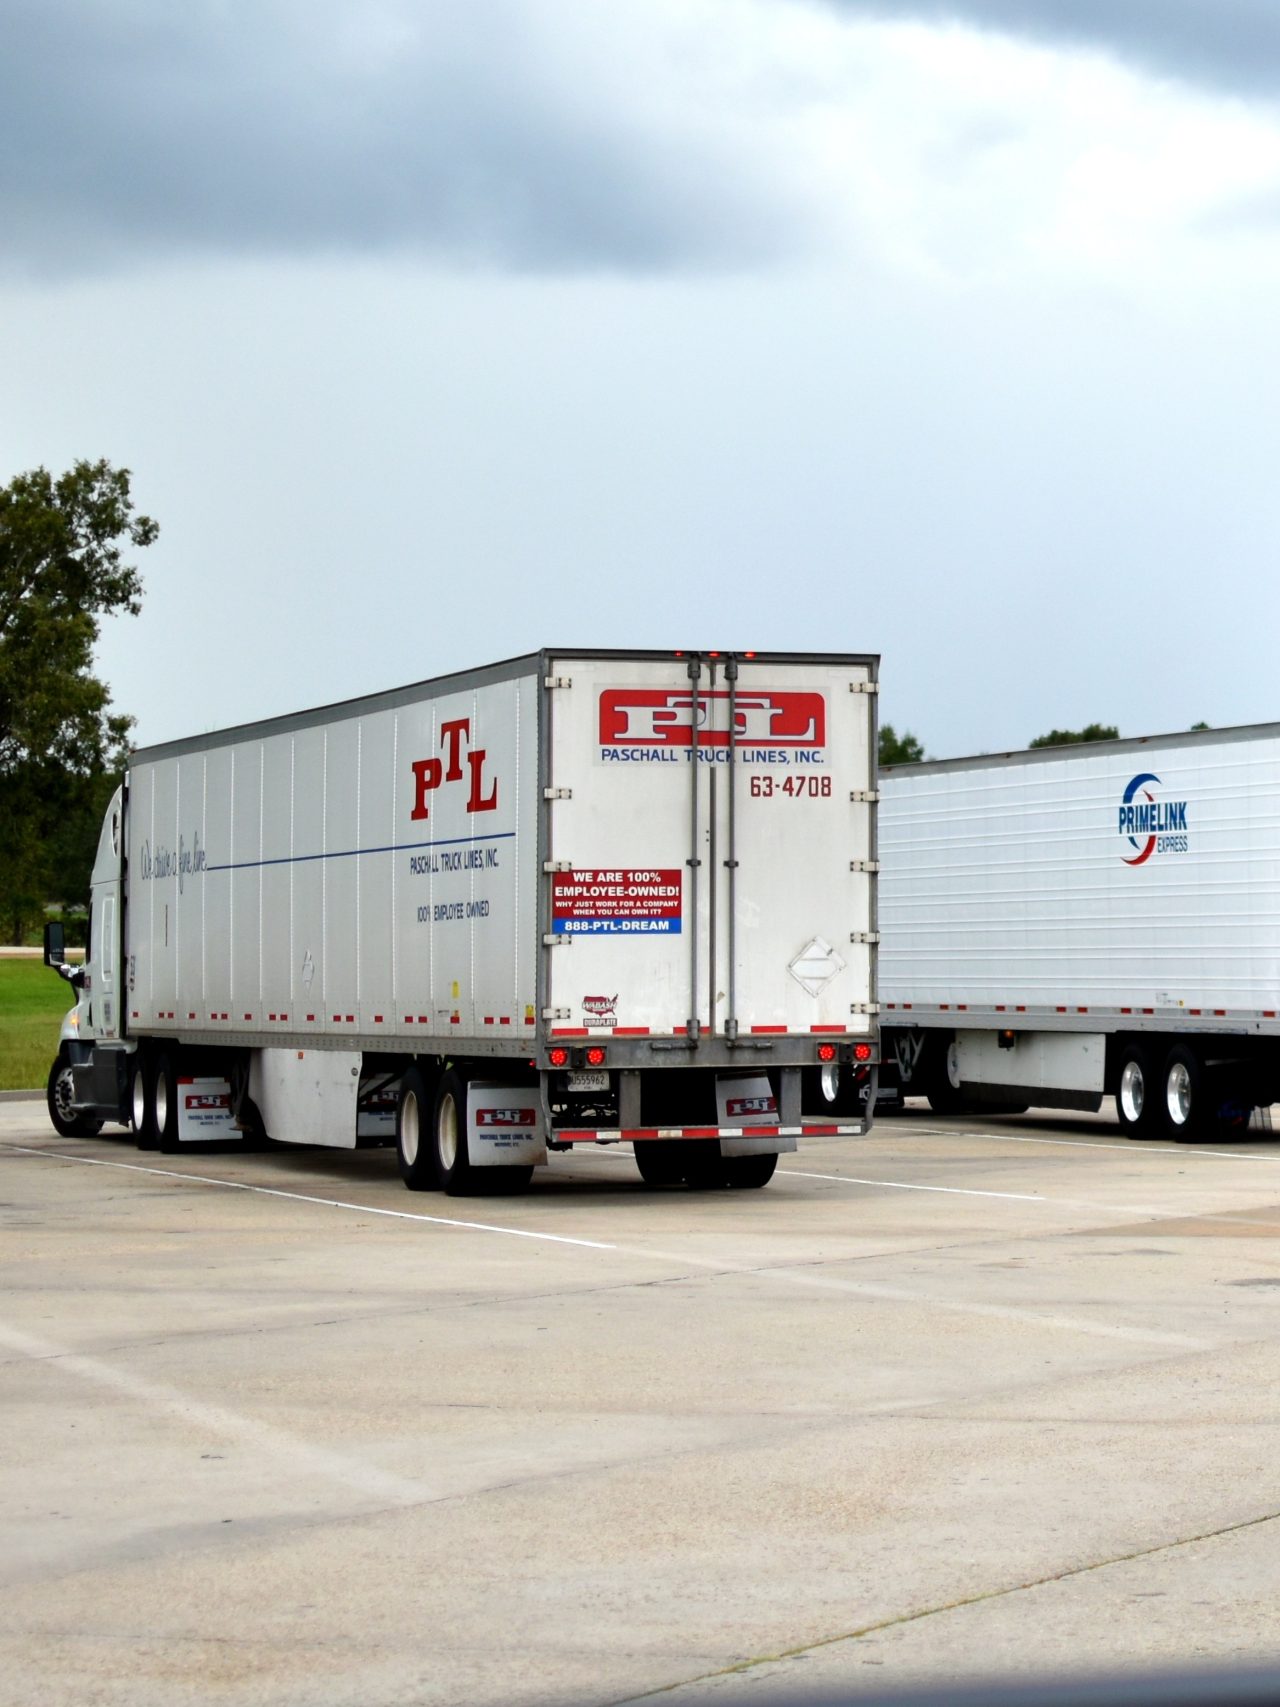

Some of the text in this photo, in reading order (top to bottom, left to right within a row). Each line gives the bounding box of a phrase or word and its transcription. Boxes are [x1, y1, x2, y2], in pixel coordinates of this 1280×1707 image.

[613, 695, 816, 742] PTL
[601, 748, 825, 765] PASCHALL TRUCK LINES, INC.
[410, 717, 498, 821] PTL
[750, 776, 832, 798] 63-4708
[1118, 801, 1188, 835] PRIMELINK
[1157, 835, 1188, 853] EXPRESS
[410, 854, 440, 876] PASCHALL
[440, 851, 462, 873] TRUCK
[485, 848, 500, 868] INC.
[573, 872, 662, 882] WE ARE 100%
[555, 886, 680, 897] EMPLOYEE-OWNED!
[434, 902, 464, 921] EMPLOYEE
[466, 900, 490, 918] OWNED
[564, 921, 670, 931] 888-PTL-DREAM
[582, 1001, 618, 1011] WABASH
[481, 1109, 532, 1124] PTL
